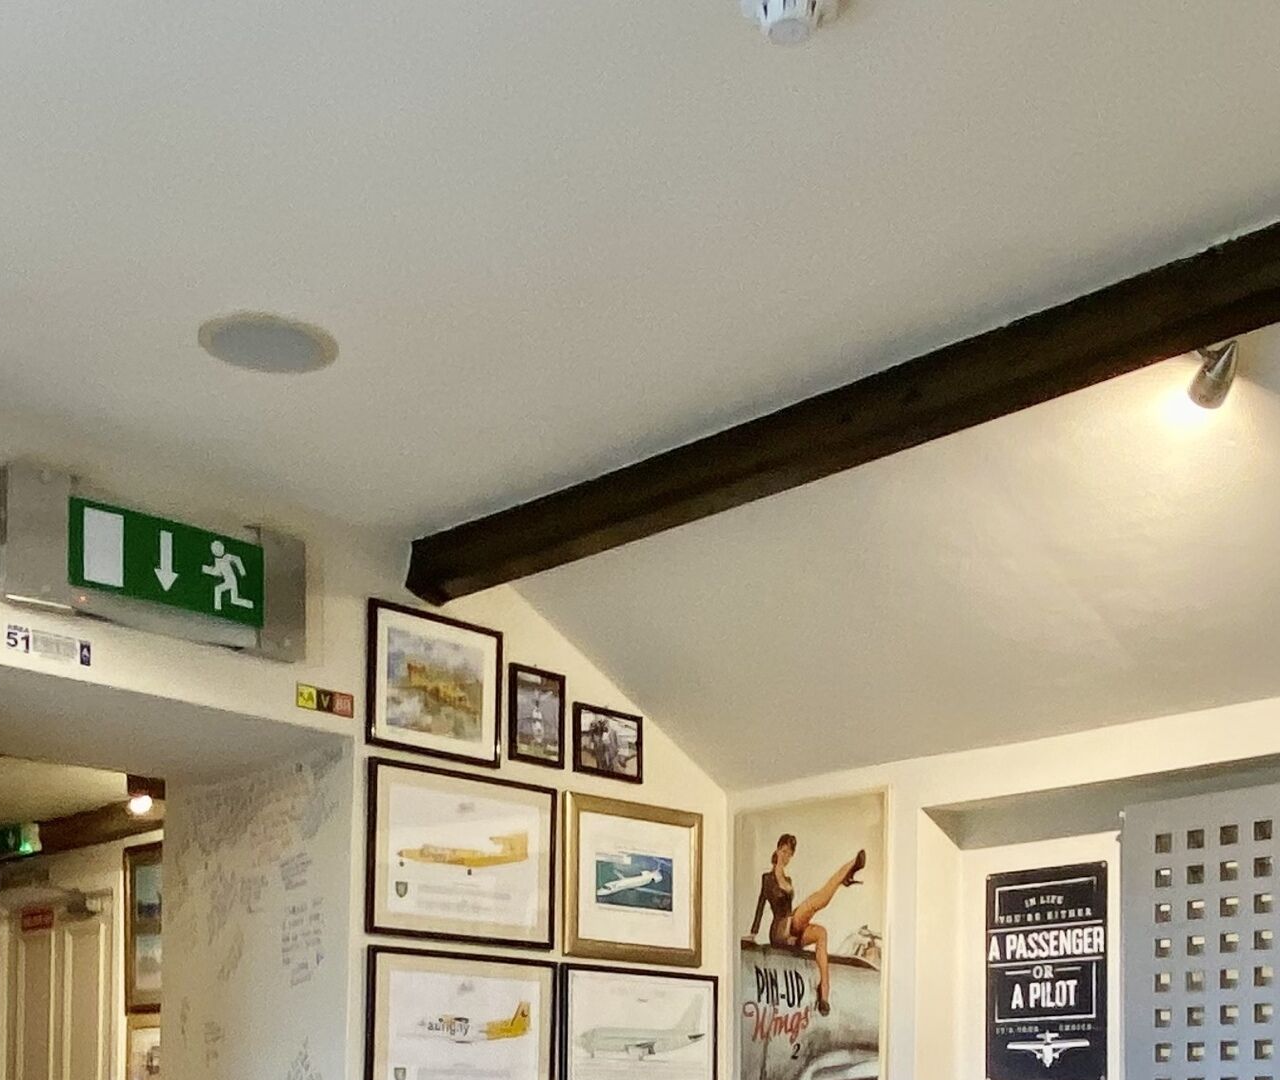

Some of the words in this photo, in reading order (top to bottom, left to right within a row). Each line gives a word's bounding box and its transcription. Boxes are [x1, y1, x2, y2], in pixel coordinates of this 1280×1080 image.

[6, 631, 30, 654] 51
[1024, 897, 1037, 908] IN
[1040, 894, 1064, 905] LIFE
[1046, 907, 1092, 920] EITHER
[988, 935, 1000, 962] A
[1006, 926, 1105, 960] PASSENGER
[1032, 965, 1054, 979] OR
[754, 965, 805, 1008] PIN-UP
[1011, 983, 1023, 1010] A
[1029, 980, 1078, 1009] PILOT
[743, 1000, 810, 1045] Wings
[790, 1043, 801, 1060] 2
